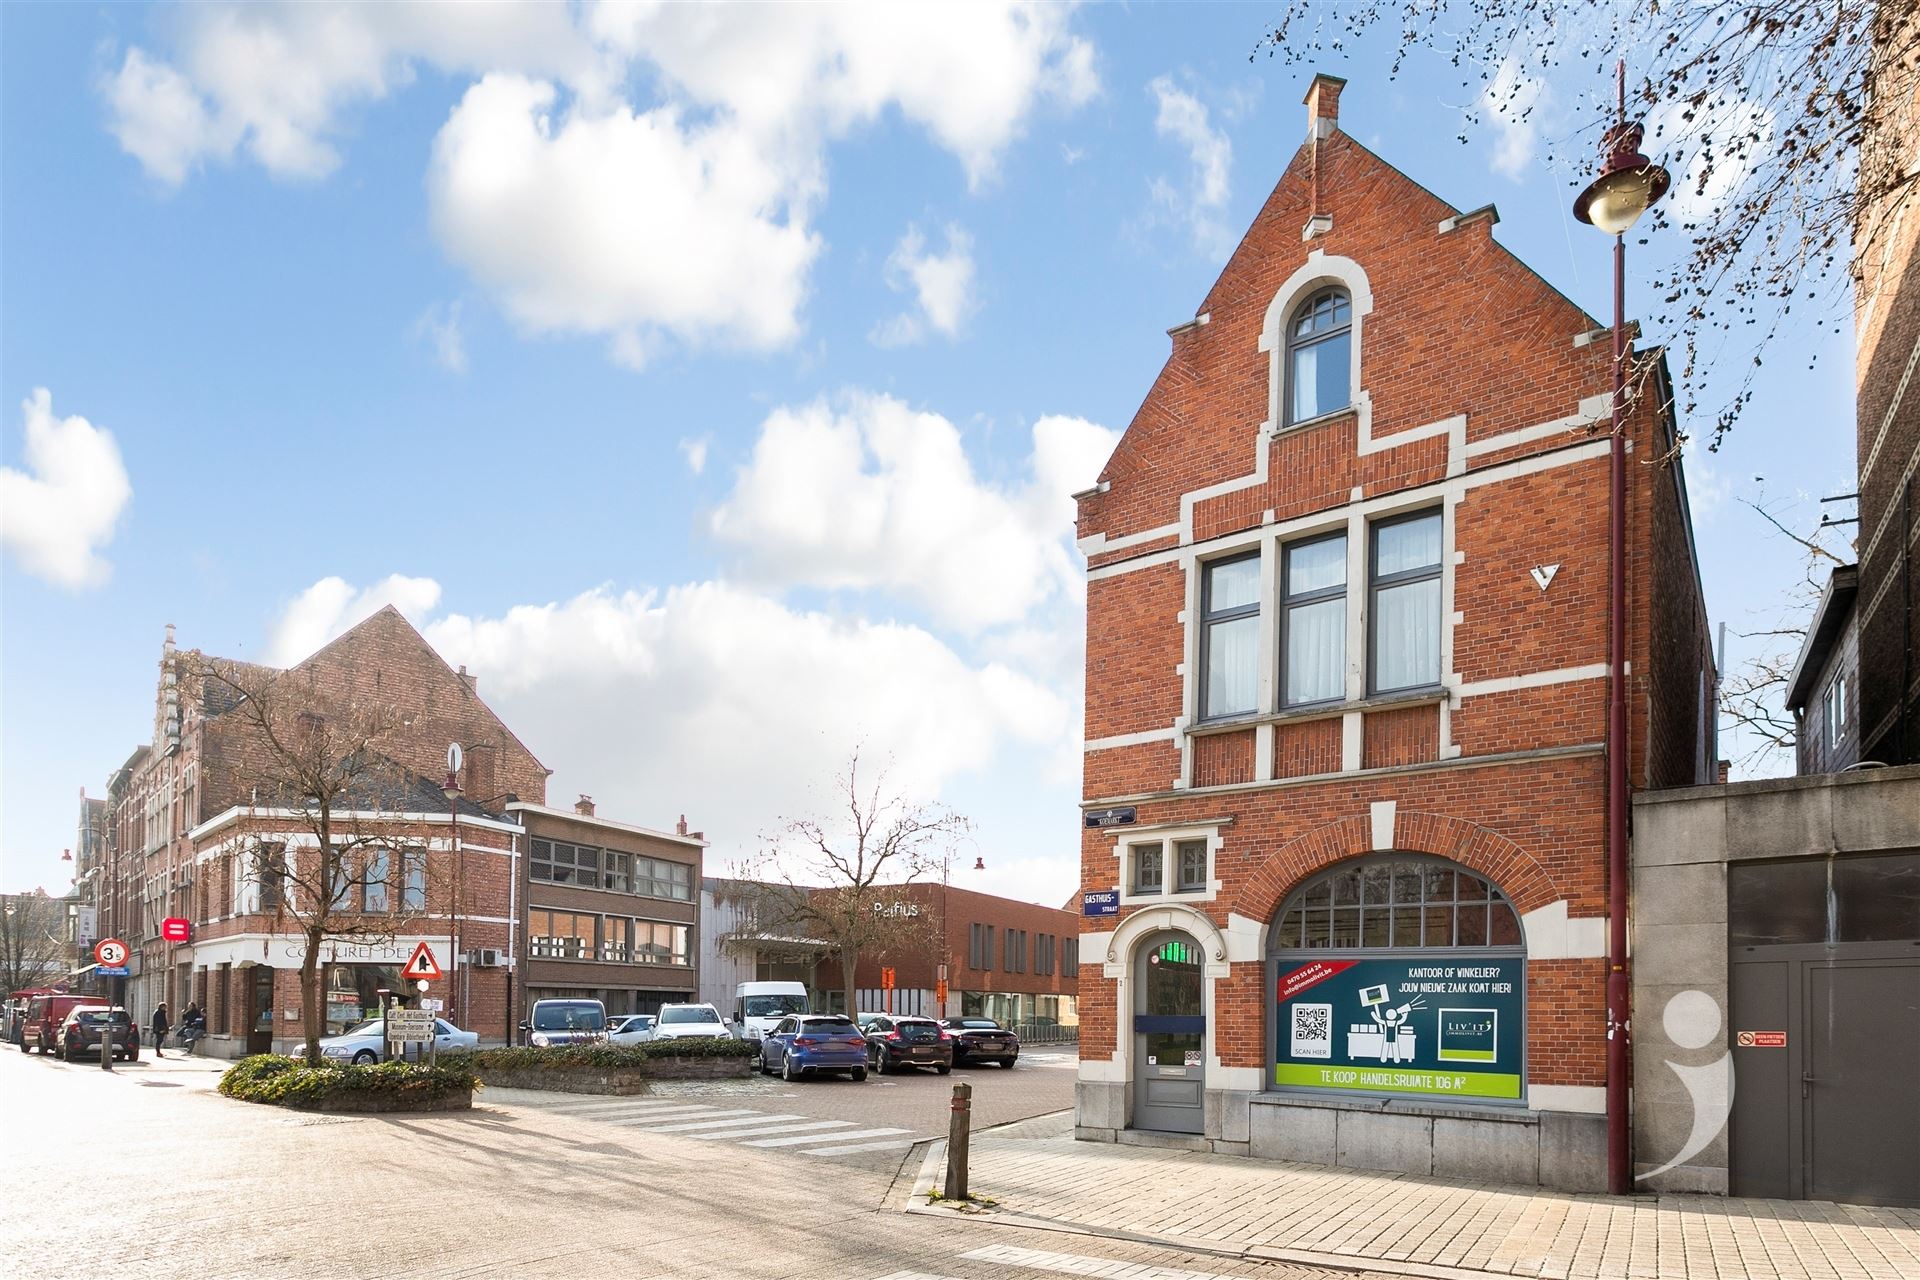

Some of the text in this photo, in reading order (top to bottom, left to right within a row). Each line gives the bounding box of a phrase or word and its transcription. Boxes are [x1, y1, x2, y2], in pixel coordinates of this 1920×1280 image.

[1408, 967, 1500, 978] KANTOOR OF WINKELIER?
[1283, 968, 1332, 995] info@immolivit.be
[1398, 983, 1512, 994] JOUW NIEUWE ZAAK KOMT HIER!
[1321, 1070, 1331, 1083] TE
[1333, 1071, 1357, 1084] KOOP
[1360, 1073, 1432, 1089] HANDELSRUIMTE
[1436, 1077, 1451, 1090] 106
